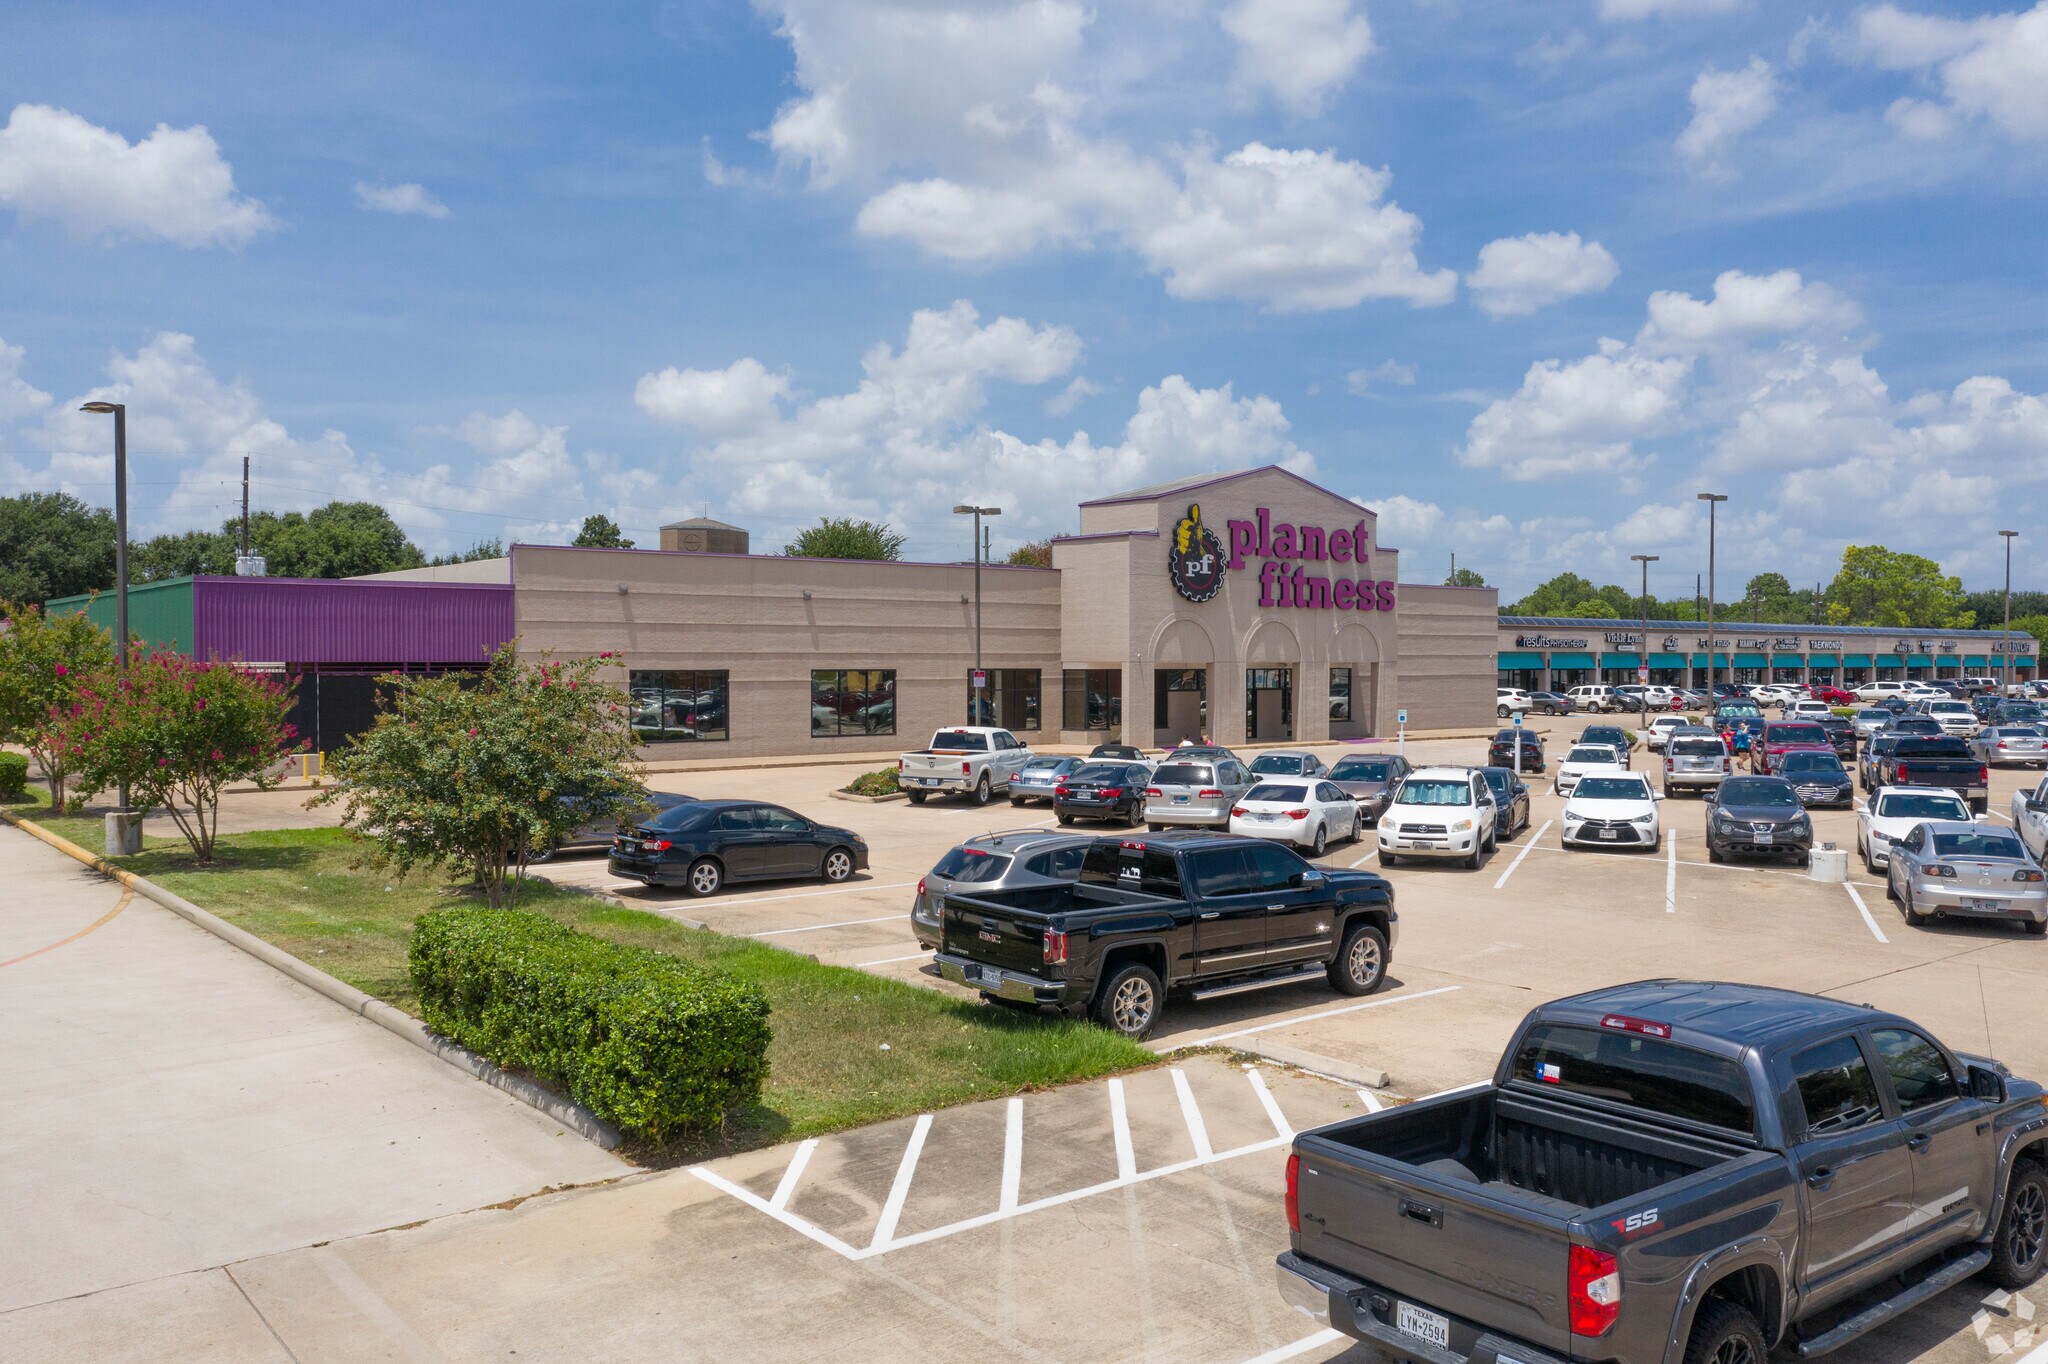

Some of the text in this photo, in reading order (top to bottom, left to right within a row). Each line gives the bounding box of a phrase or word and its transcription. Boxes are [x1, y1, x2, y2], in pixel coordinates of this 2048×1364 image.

[1227, 507, 1369, 570] planet
[1185, 553, 1215, 577] pf
[1258, 561, 1396, 611] fitness
[1523, 634, 1550, 648] results
[1810, 641, 1844, 650] TAEKWONDO
[1670, 699, 1683, 707] STOP
[979, 931, 1001, 944] GMC
[1611, 1207, 1658, 1234] TSS
[1413, 1309, 1433, 1322] TEXAS
